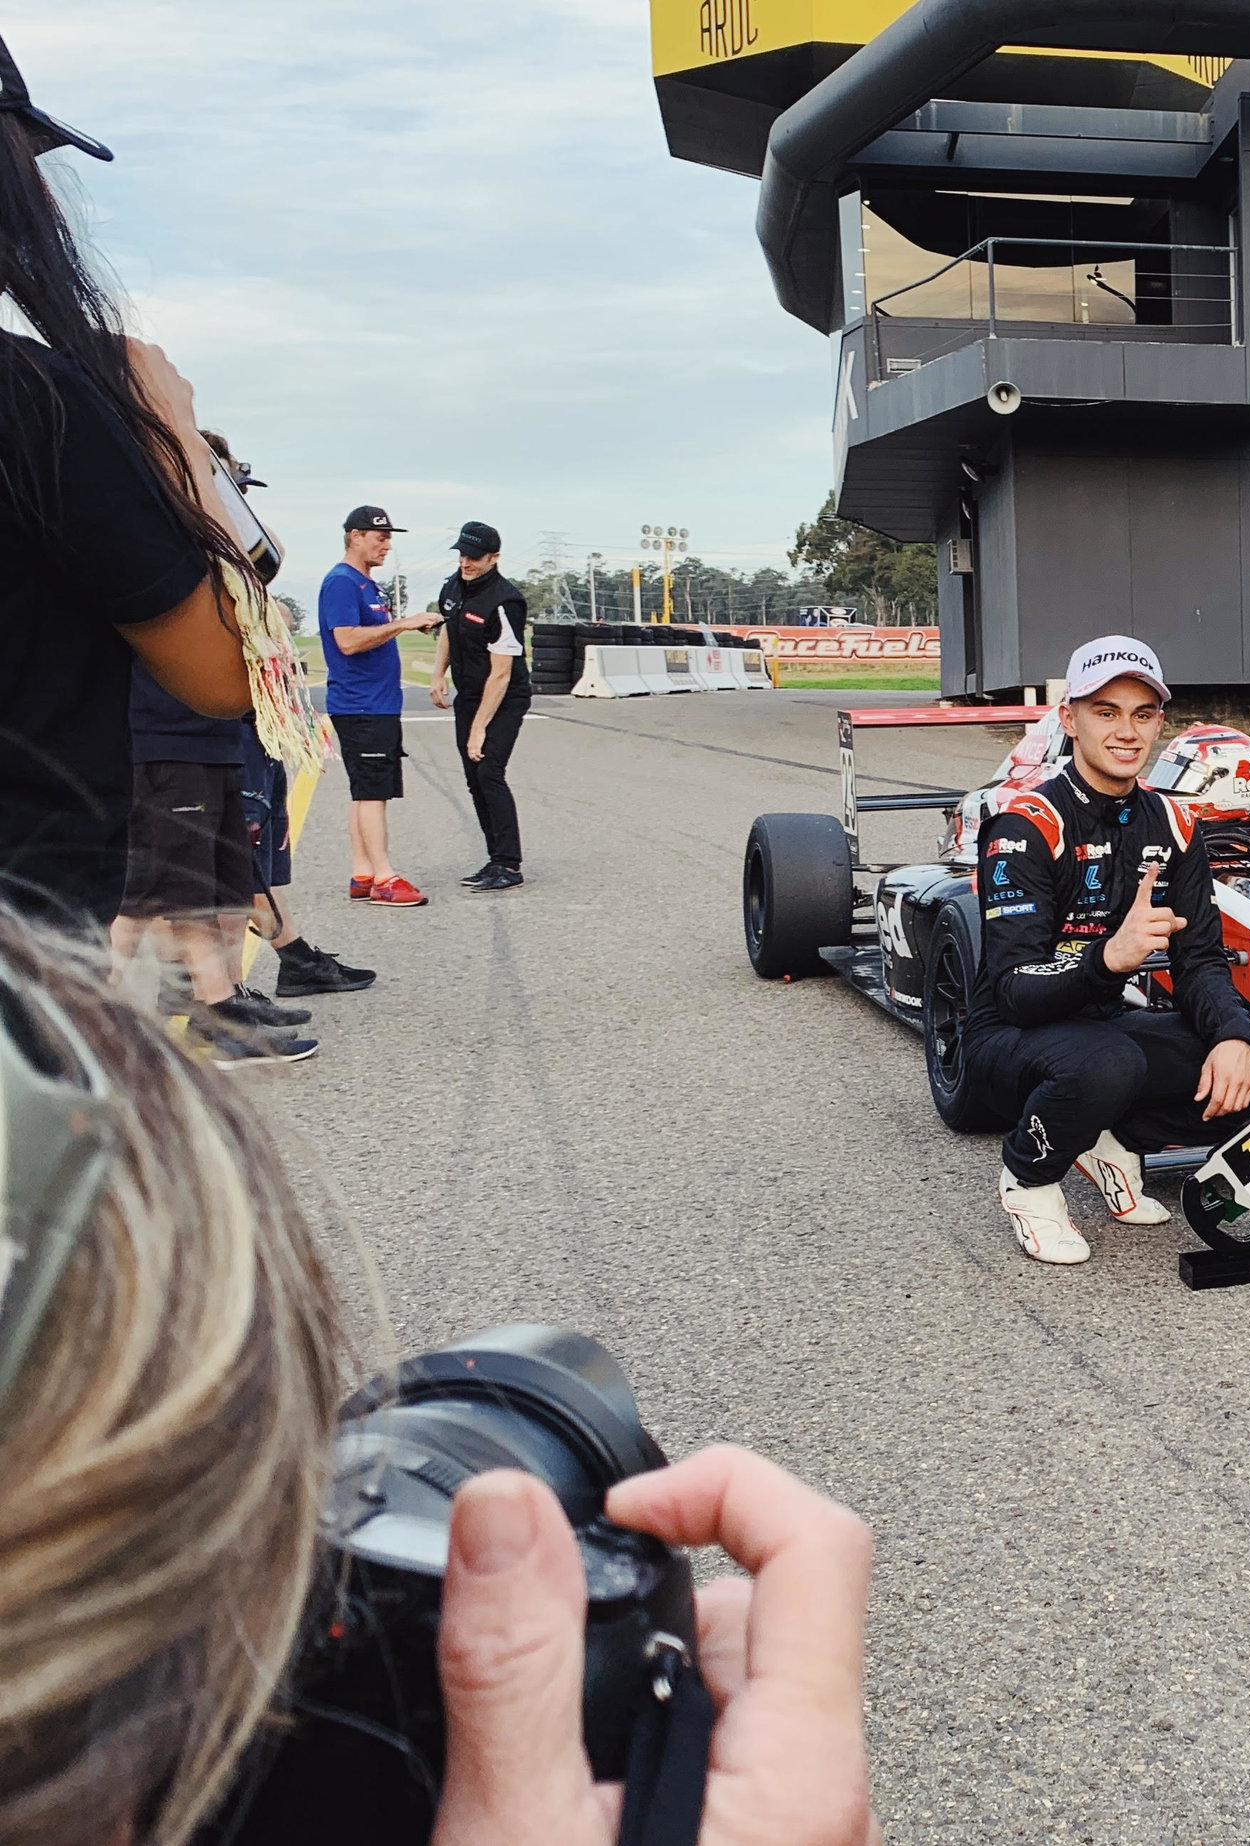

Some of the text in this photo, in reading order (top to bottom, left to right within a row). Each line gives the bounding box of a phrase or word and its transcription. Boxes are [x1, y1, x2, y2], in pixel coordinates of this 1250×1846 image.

[700, 0, 758, 57] ARDC
[749, 631, 941, 659] RaceFuels
[999, 837, 1027, 852] Red
[1087, 842, 1112, 857] Red
[987, 889, 1024, 902] LEEDS
[1077, 894, 1106, 904] LEES
[1002, 903, 1035, 914] SPORT
